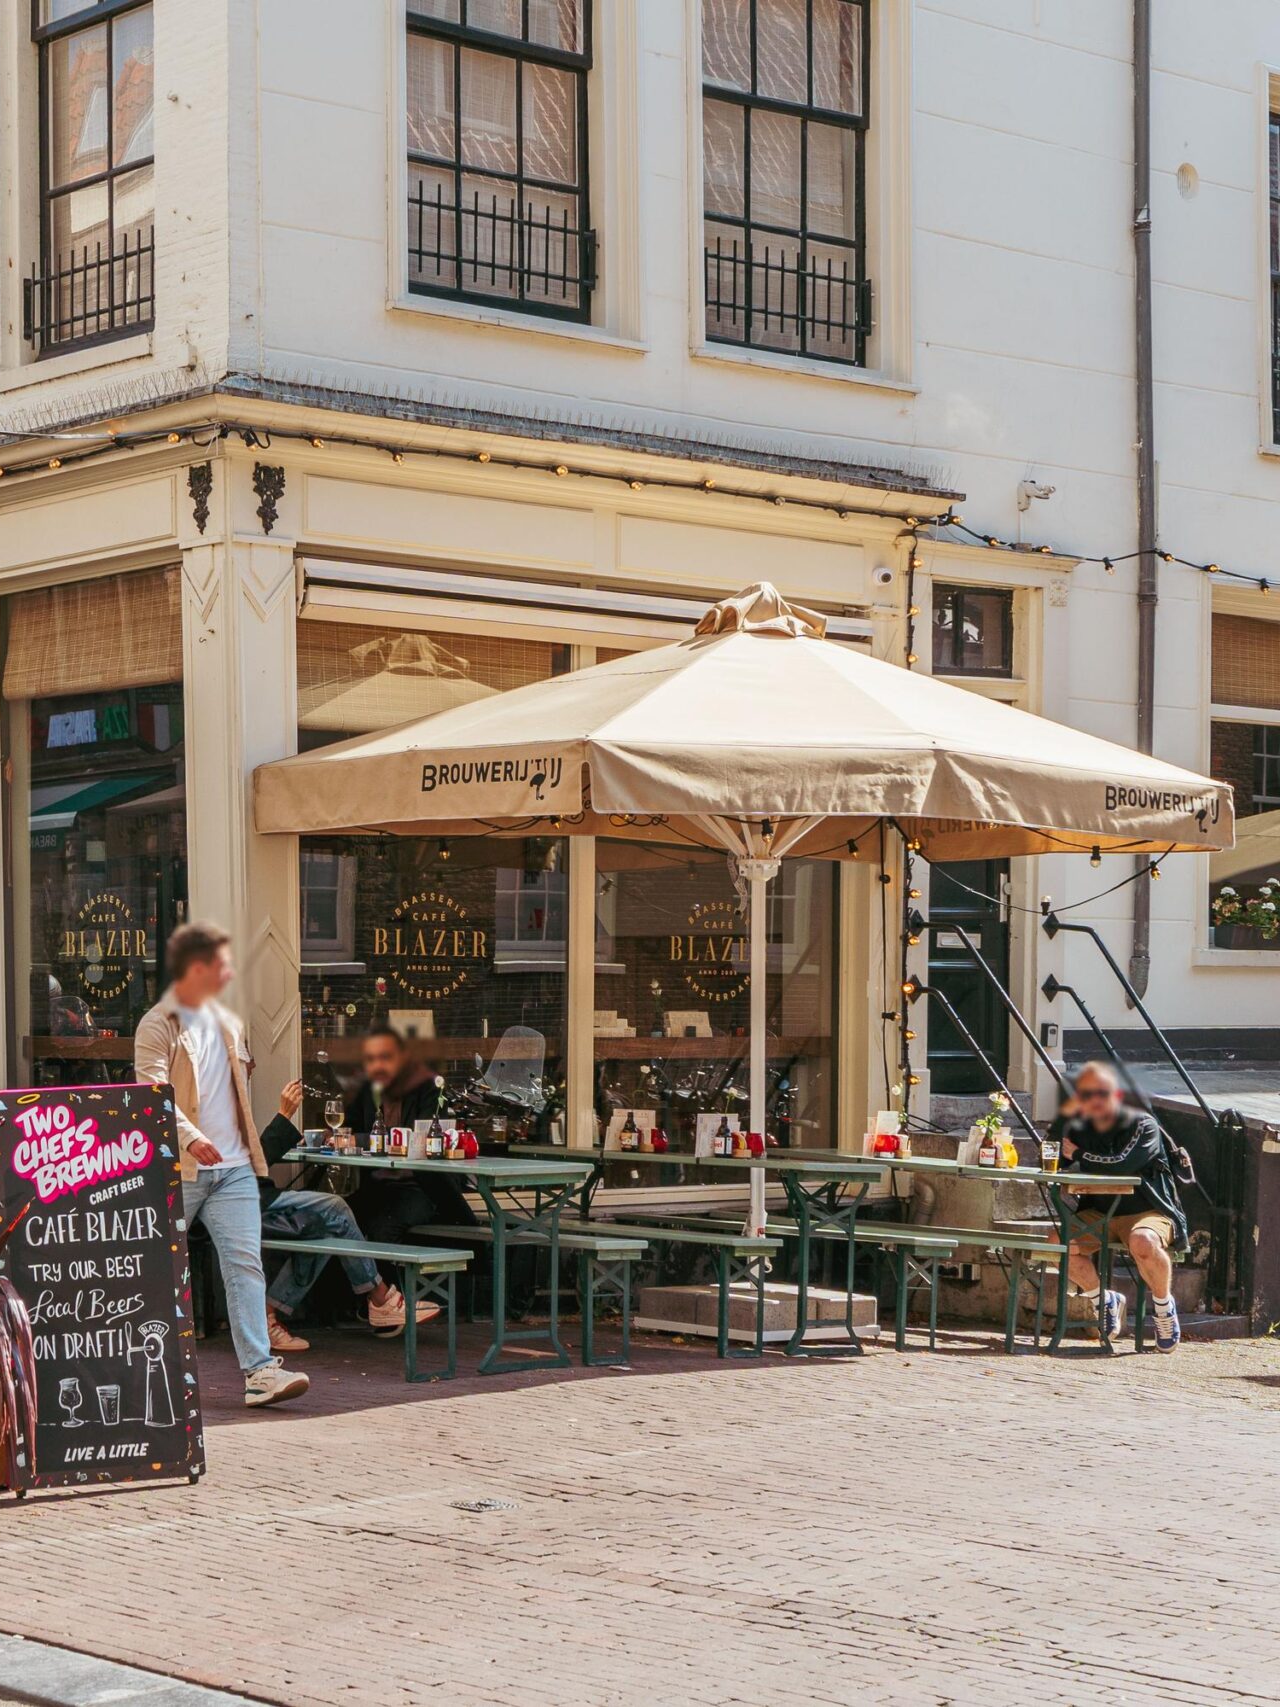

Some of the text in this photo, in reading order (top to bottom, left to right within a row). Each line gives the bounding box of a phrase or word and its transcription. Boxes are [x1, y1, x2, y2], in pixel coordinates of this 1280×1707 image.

[421, 759, 529, 792] BROUWERIJ
[1105, 785, 1195, 813] BROUWERIJ
[79, 894, 131, 919] BRASSERIE
[394, 892, 467, 919] BRASSERIE
[412, 911, 446, 922] CAFÉ
[65, 929, 147, 957] BLAZER
[373, 928, 487, 958] BLAZER
[670, 935, 750, 962] BLAZE
[79, 971, 134, 999] AMSTERDAM
[392, 971, 467, 999] AMSTERDAM
[686, 975, 751, 1001] AMSTERDAM
[15, 1105, 71, 1138] TWO
[14, 1118, 96, 1174] CHEFS
[32, 1130, 149, 1199] BREWING
[89, 1175, 145, 1206] CRAFT BEER
[25, 1206, 163, 1247] CAFÉ BLAZER
[28, 1254, 144, 1283] TRY OUR BEST
[28, 1288, 145, 1325] Local Beers
[141, 1323, 165, 1335] BLAZER
[33, 1328, 124, 1360] ON DRAFT!
[64, 1442, 149, 1463] LIVE A LITTLE
